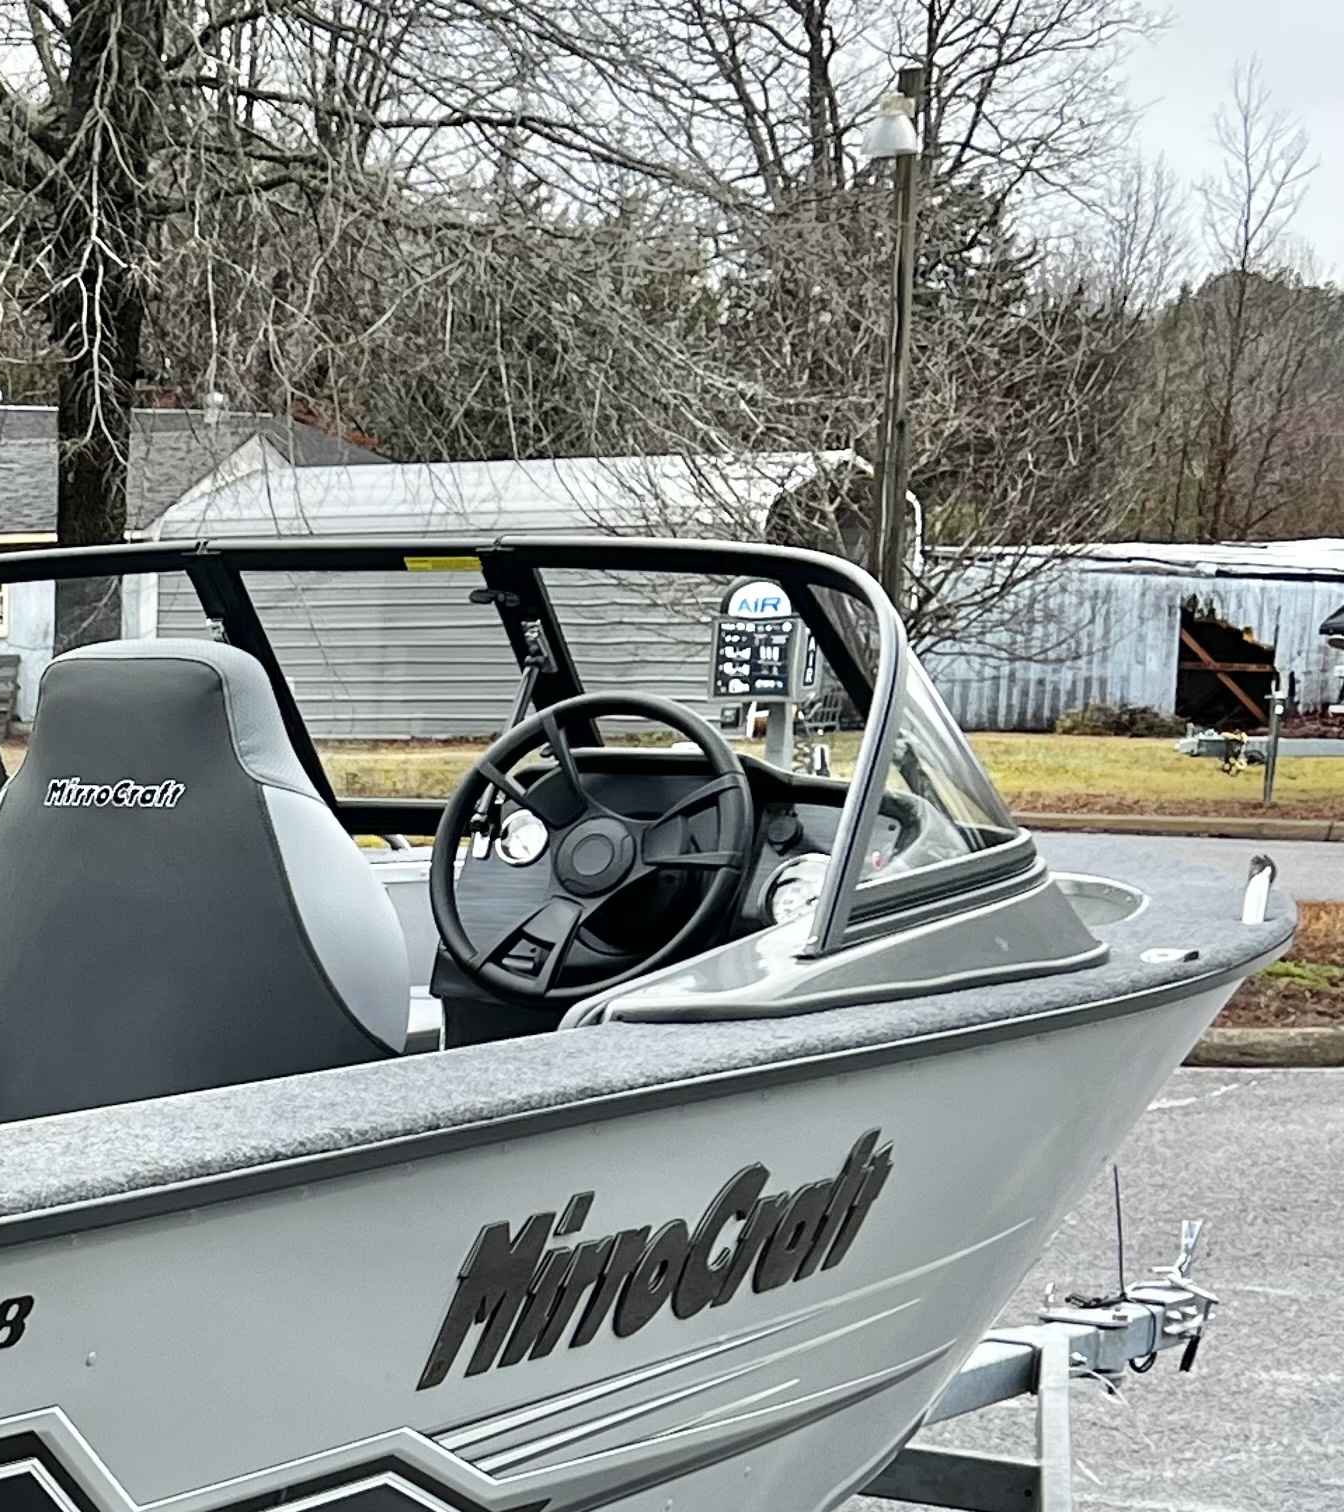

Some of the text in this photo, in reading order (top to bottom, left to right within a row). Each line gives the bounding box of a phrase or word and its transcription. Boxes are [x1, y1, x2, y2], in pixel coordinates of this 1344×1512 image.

[738, 597, 782, 613] AIR
[43, 777, 186, 808] MirroCraft
[416, 1127, 894, 1391] MirroCraft
